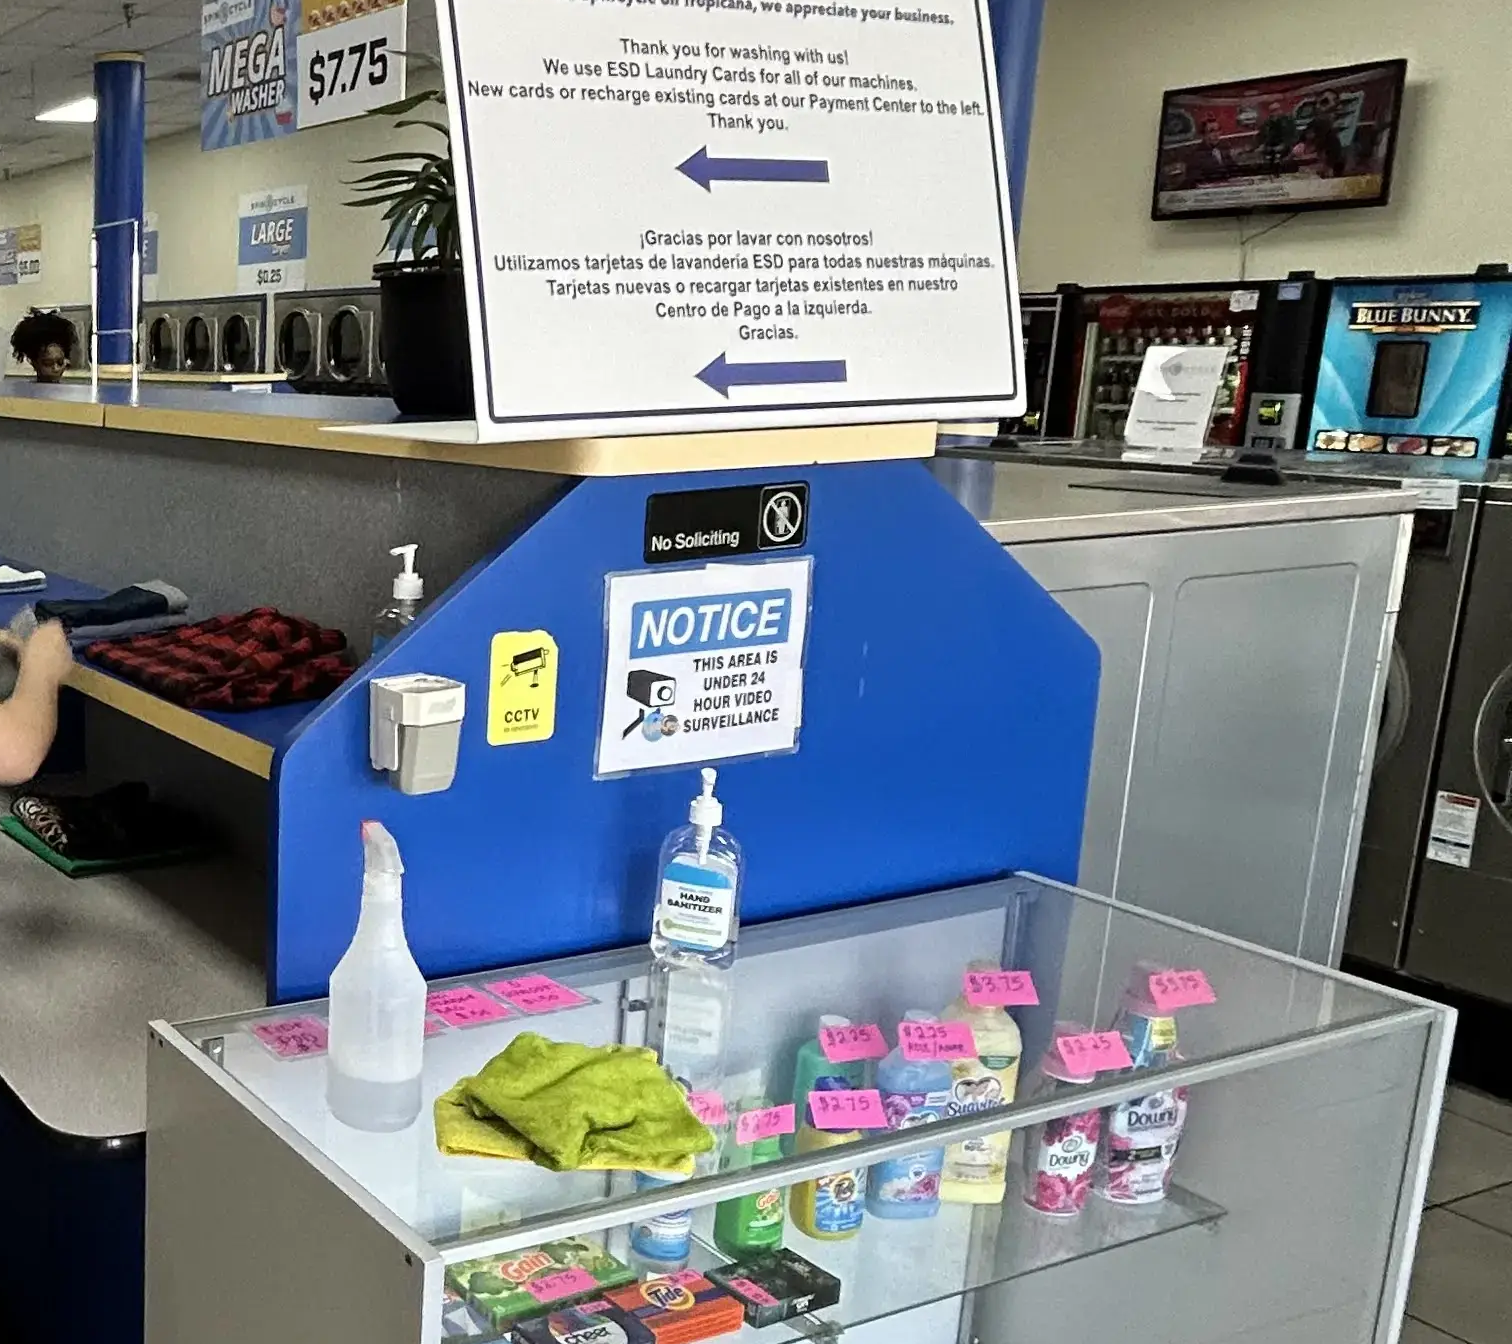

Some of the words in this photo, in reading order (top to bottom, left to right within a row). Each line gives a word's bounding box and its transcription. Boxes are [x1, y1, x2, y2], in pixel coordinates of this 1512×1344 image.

[760, 0, 782, 13] we
[786, 0, 858, 19] appreciate
[861, 7, 892, 23] your
[207, 26, 286, 97] MEGA
[620, 38, 669, 56] Thank
[672, 43, 700, 60] you
[705, 42, 725, 58] for
[729, 44, 791, 66] washing
[793, 47, 823, 64] with
[827, 49, 849, 66] us!
[309, 37, 388, 106] $7.75
[542, 58, 569, 75] We
[574, 63, 602, 76] use
[607, 61, 640, 78] ESD
[645, 63, 707, 84] Laundry
[712, 66, 756, 83] Cards
[760, 68, 780, 84] for
[784, 69, 800, 86] all
[804, 70, 818, 86] of
[823, 74, 845, 87] our
[849, 74, 918, 92] machines.
[231, 79, 286, 117] WASHER
[468, 80, 504, 97] New
[509, 83, 554, 99] cards
[559, 86, 576, 100] or
[581, 85, 650, 105] recharge
[655, 88, 715, 107] existing
[719, 90, 760, 107] cards
[764, 93, 777, 107] at
[781, 95, 805, 108] our
[809, 94, 869, 113] Payment
[873, 96, 917, 113] Center
[920, 99, 934, 114] to
[937, 100, 957, 115] the
[706, 112, 753, 130] Thank
[757, 116, 788, 134] you.
[250, 218, 294, 246] LARGE
[640, 229, 703, 249] ¡Gracias
[708, 233, 732, 249] por
[737, 230, 772, 246] lavar
[776, 233, 802, 246] con
[807, 230, 873, 246] nosotros!
[494, 254, 580, 271] Utilizamos
[585, 253, 644, 274] tarjetas
[648, 253, 667, 269] de
[754, 253, 784, 269] ESD
[788, 256, 820, 272] para
[823, 254, 862, 269] todas
[866, 254, 924, 269] nuestras
[546, 279, 610, 299] Tarjetas
[615, 282, 671, 295] nuevas
[676, 283, 685, 294] o
[689, 281, 751, 297] recargar
[756, 277, 809, 297] tarjetas
[813, 276, 884, 292] existentes
[888, 279, 904, 291] en
[908, 277, 958, 291] nuestro
[655, 302, 707, 318] Centro
[711, 302, 729, 317] de
[734, 301, 770, 320] Pago
[775, 304, 783, 316] a
[787, 300, 800, 316] la
[804, 300, 872, 319] izquierda.
[1356, 307, 1398, 324] BLUE
[739, 324, 799, 340] Gracias.
[651, 535, 672, 552] No
[675, 529, 739, 550] Soliciting
[638, 598, 786, 649] NOTICE
[693, 656, 724, 673] THIS
[728, 651, 761, 669] AREA
[766, 650, 778, 664] IS
[703, 673, 747, 691] UNDER
[751, 670, 765, 686] 24
[693, 695, 731, 712] HOUR
[734, 689, 772, 707] VIDEO
[504, 708, 540, 723] CCTV
[683, 708, 779, 733] SURVEILLANCE
[667, 899, 723, 914] SANITIZER
[679, 892, 710, 903] HAND
[1128, 1107, 1178, 1128] Downy
[1049, 1152, 1089, 1168] Downy
[500, 1252, 554, 1283] Gain
[648, 1285, 685, 1308] Tide
[565, 1326, 613, 1344] cheer
